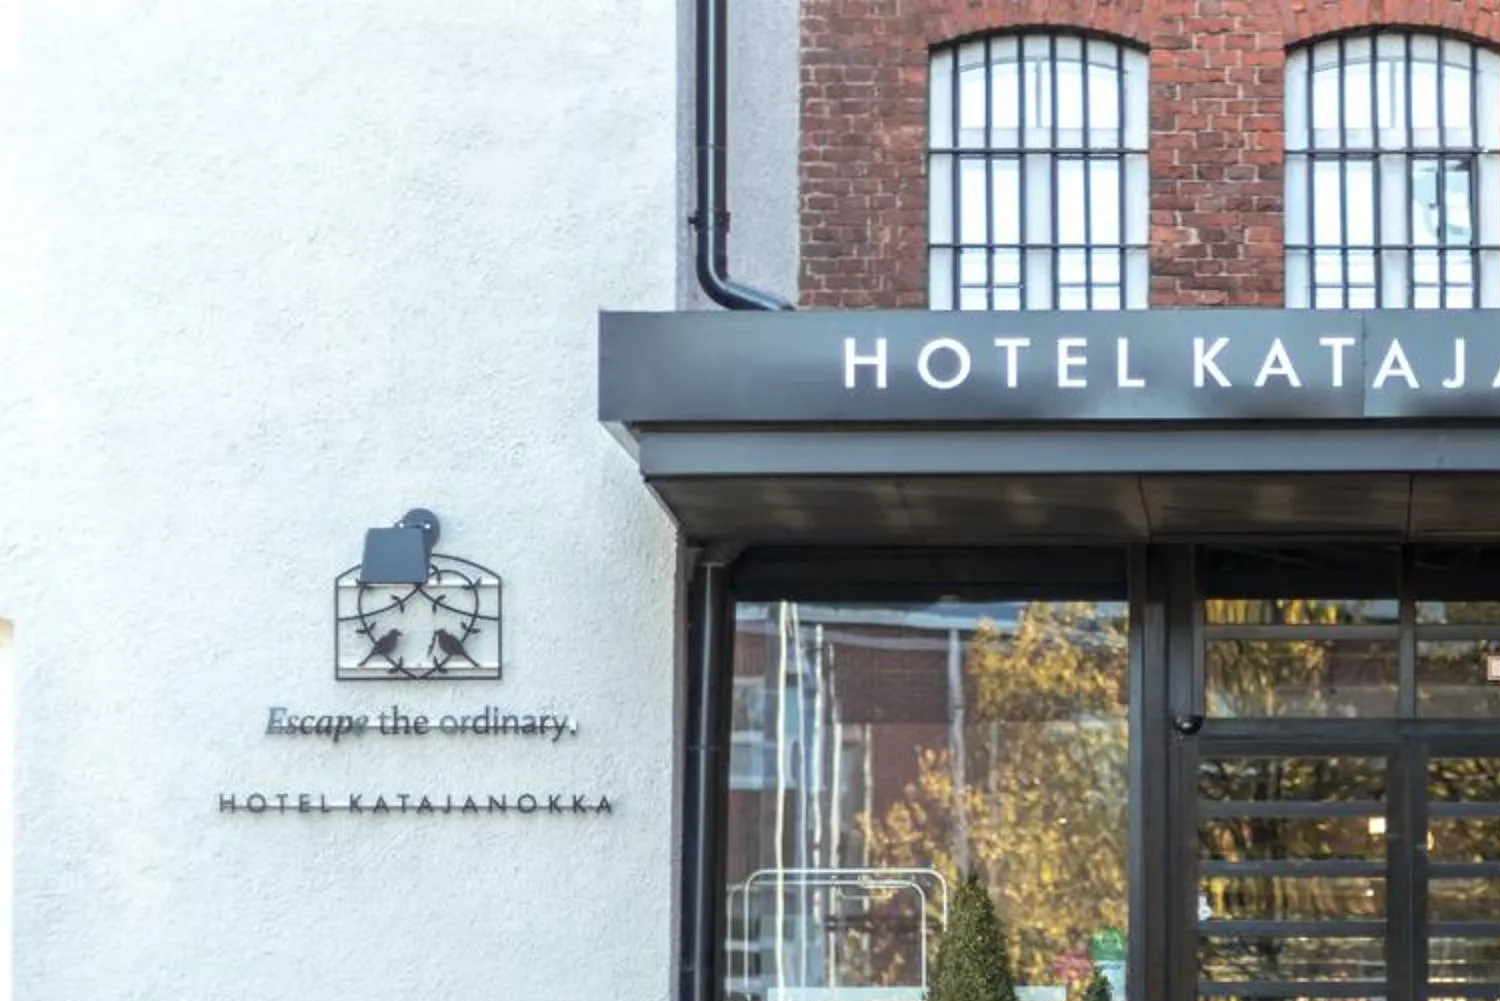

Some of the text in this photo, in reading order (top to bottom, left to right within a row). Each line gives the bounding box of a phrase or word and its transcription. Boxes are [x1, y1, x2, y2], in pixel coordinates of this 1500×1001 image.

[841, 336, 1147, 391] HOTEL
[265, 705, 578, 743] Escape the ordinary.
[219, 793, 614, 814] HOTEL KATAJANOKKA
